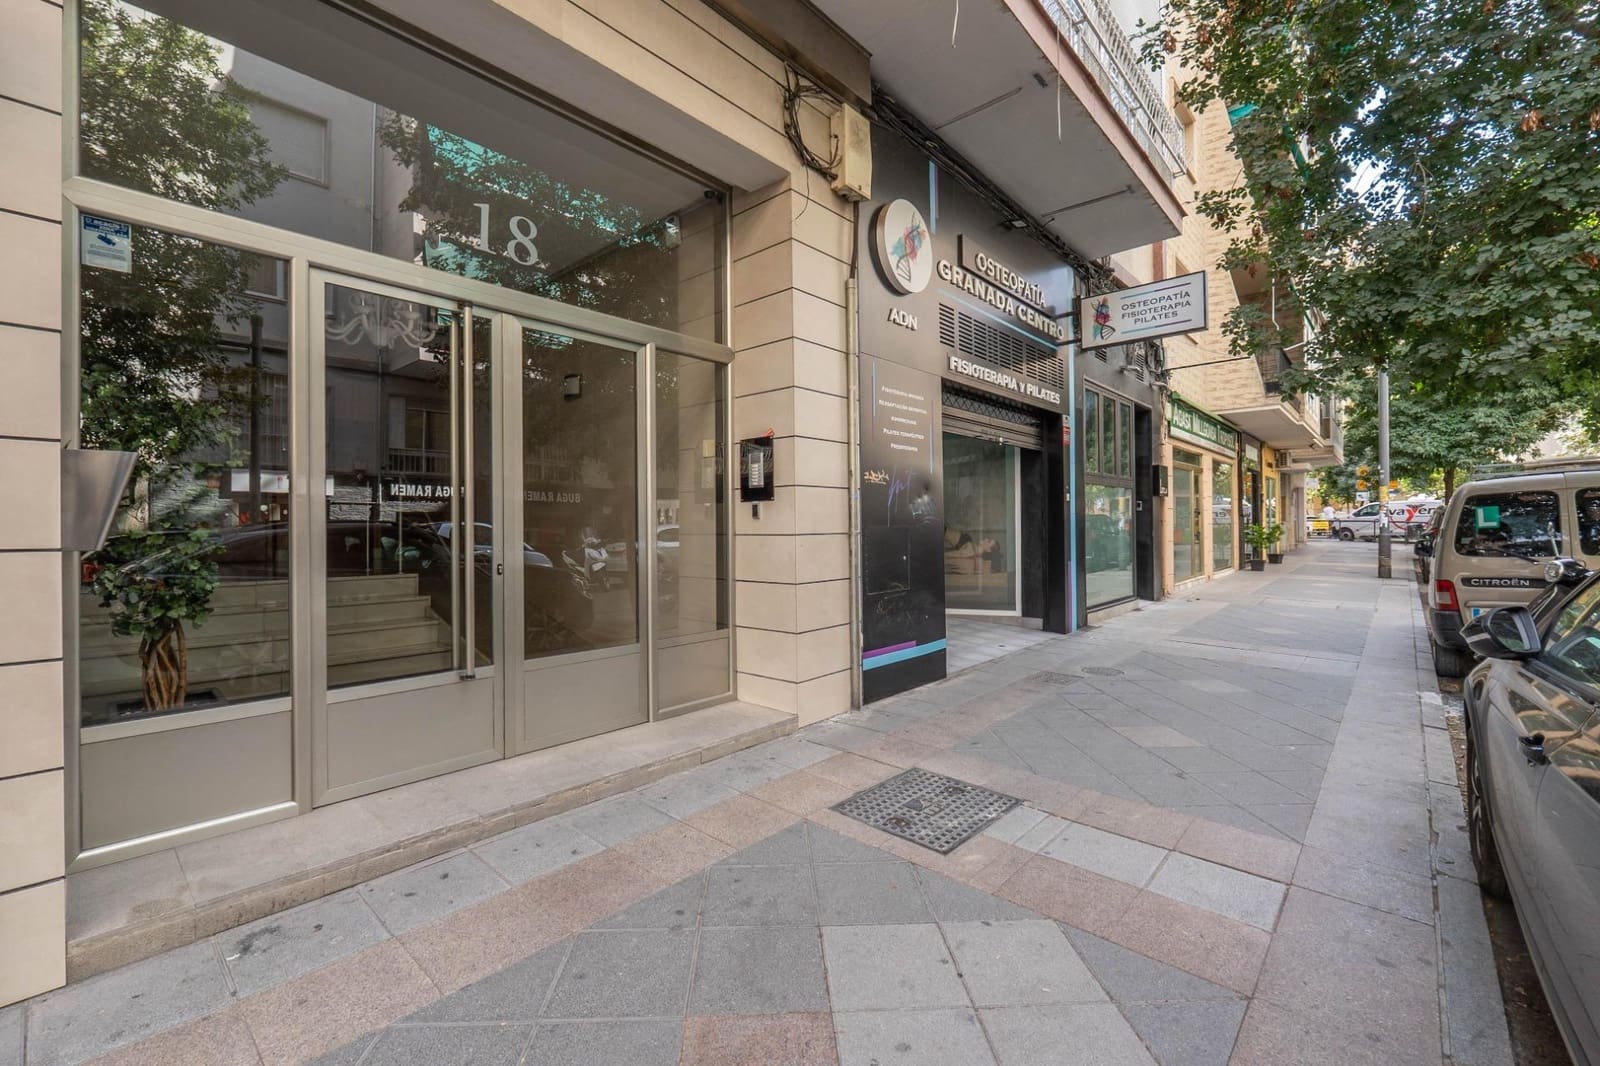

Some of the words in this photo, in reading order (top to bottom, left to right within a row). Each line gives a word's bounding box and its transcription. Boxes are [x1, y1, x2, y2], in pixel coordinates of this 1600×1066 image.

[473, 203, 539, 266] 18
[976, 252, 1047, 308] OSTEOPATÍA
[938, 259, 1015, 316] GRANADA
[1016, 304, 1064, 340] CENTRO
[1121, 290, 1191, 311] OSTEOPATÍA
[1121, 300, 1191, 320] FISIOTERAPIA
[889, 307, 918, 331] ADN
[1134, 310, 1178, 325] PILATES
[949, 355, 1018, 391] FISIOTERAPIA
[1026, 382, 1061, 405] PILATES
[1477, 507, 1498, 527] L
[1471, 577, 1530, 587] CITROËN
